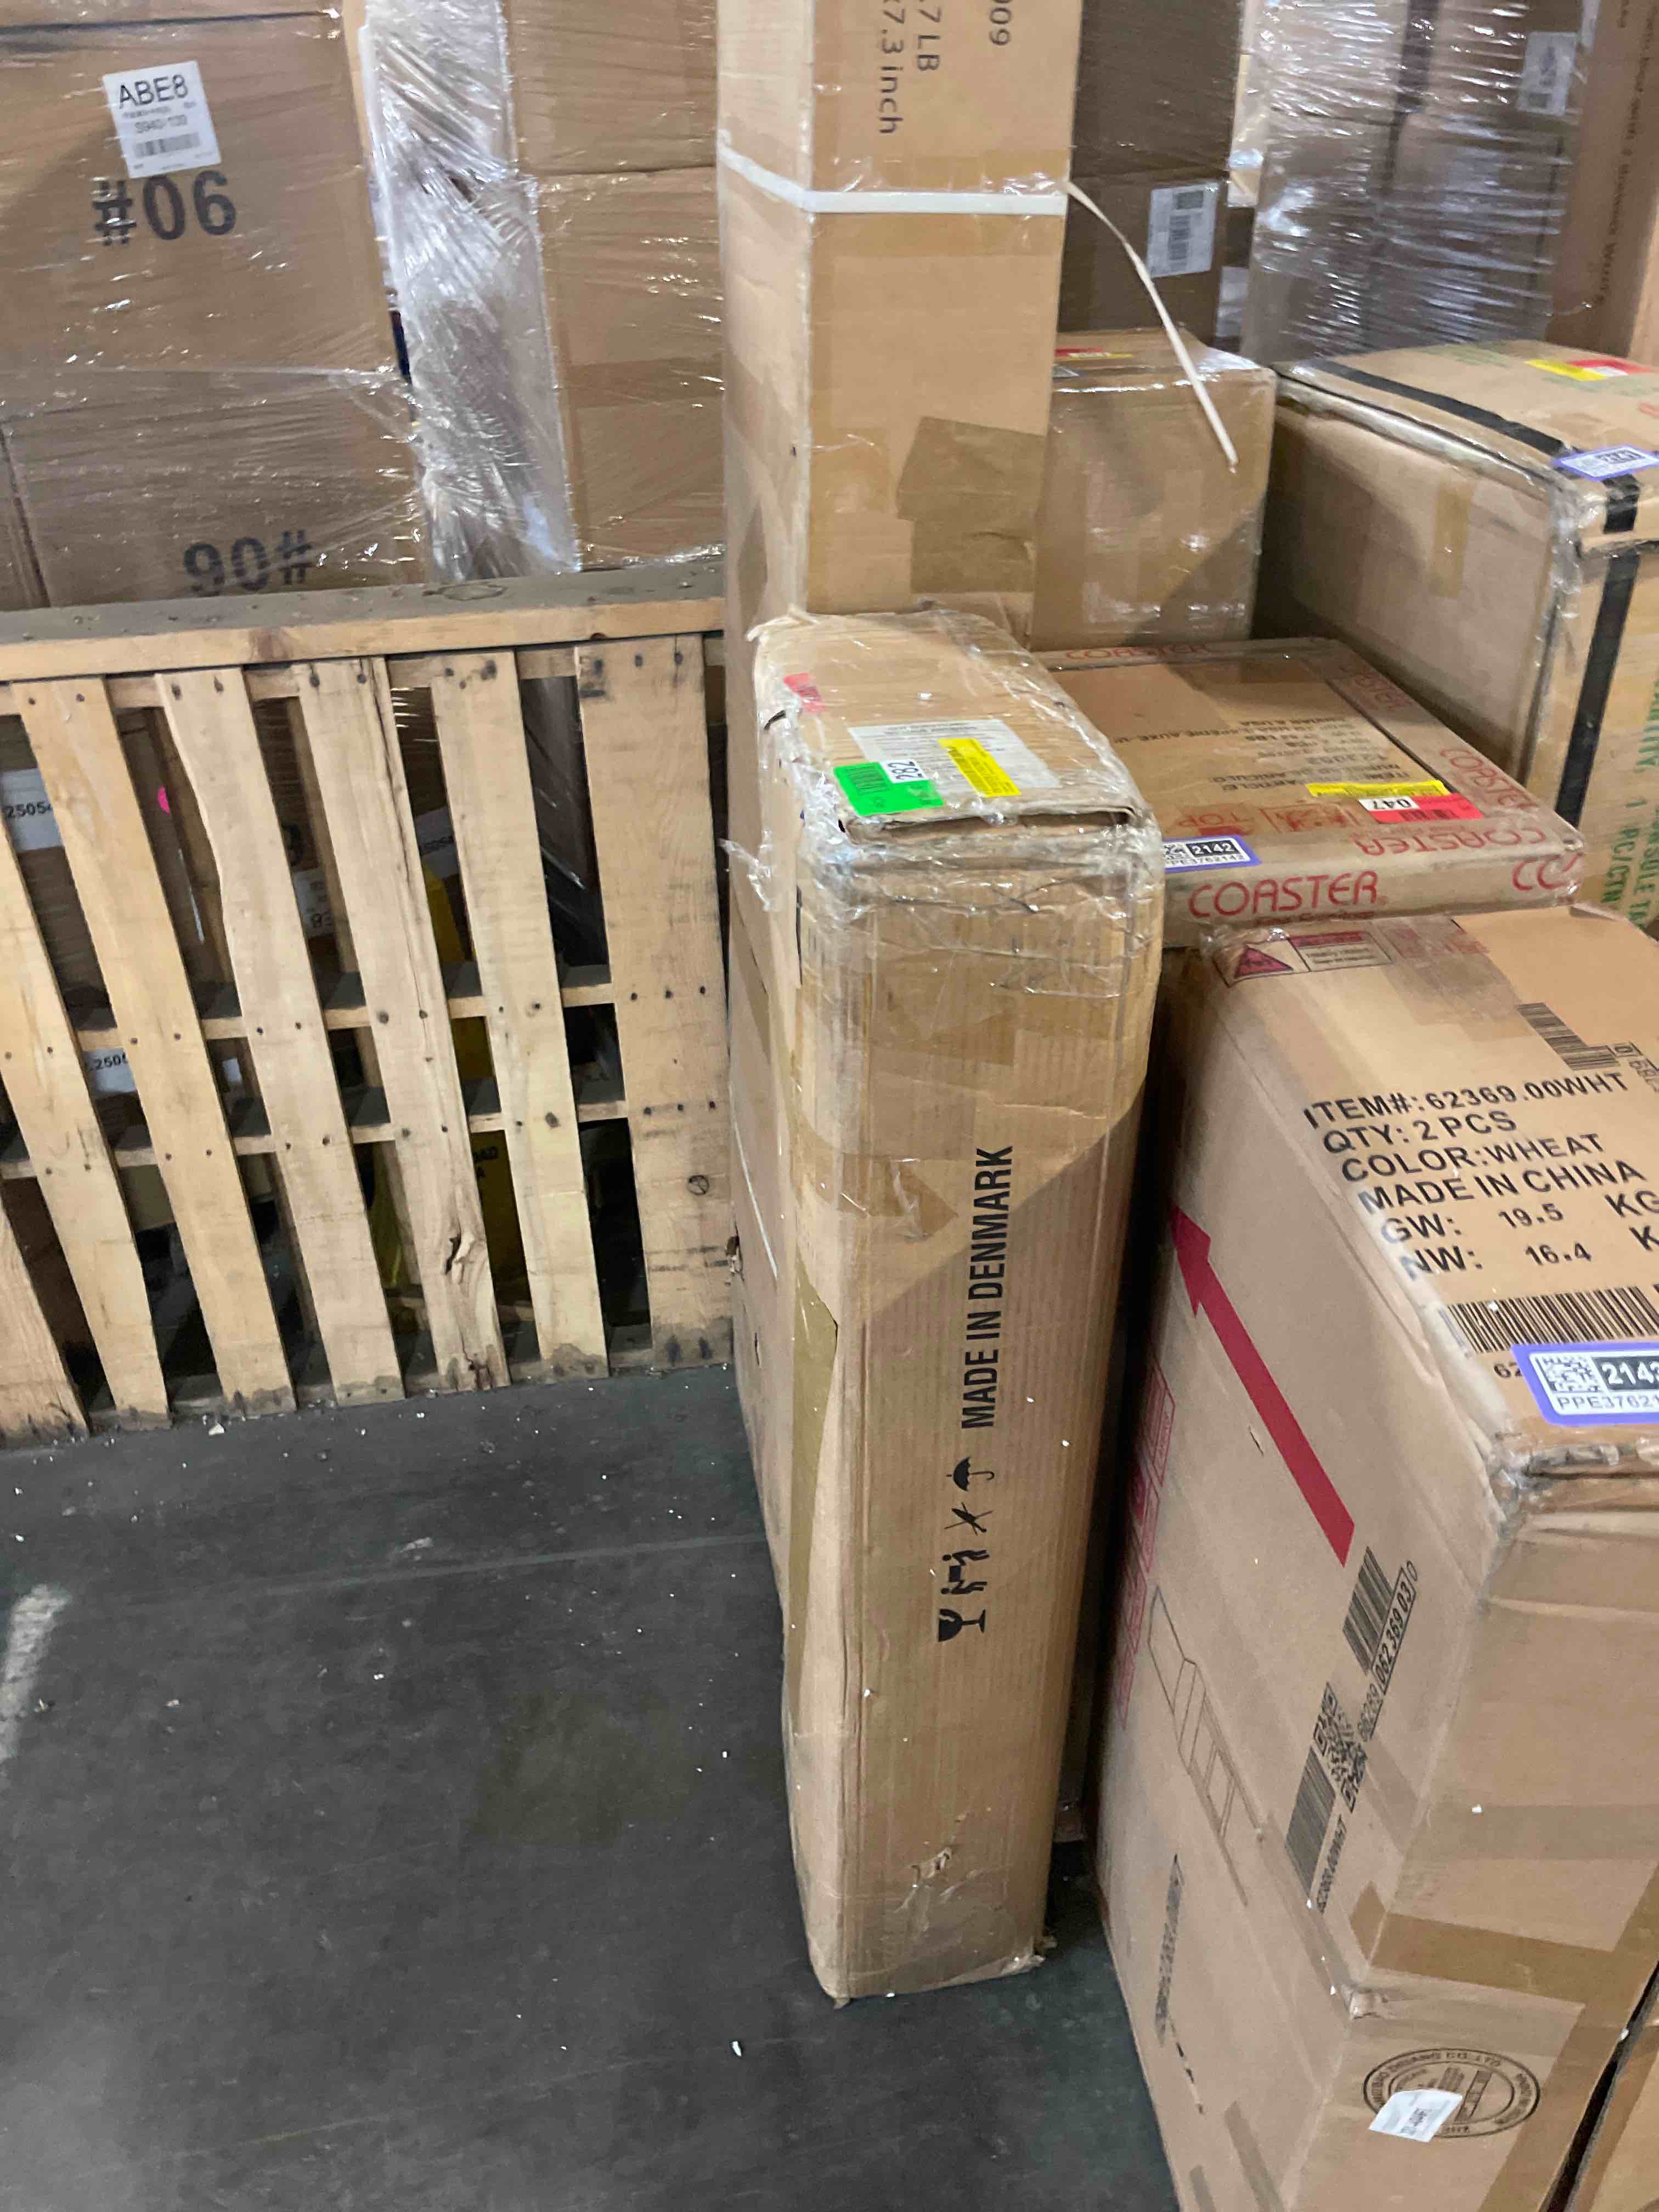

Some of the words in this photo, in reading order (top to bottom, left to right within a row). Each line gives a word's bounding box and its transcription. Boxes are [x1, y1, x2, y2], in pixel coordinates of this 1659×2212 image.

[917, 35, 941, 71] LB
[119, 74, 189, 109] ABE8
[878, 66, 904, 133] inch
[93, 170, 237, 246] #06
[887, 760, 924, 781] 282
[1372, 798, 1412, 810] 047
[1192, 842, 1235, 855] 2142
[1354, 826, 1546, 856] COASTER
[1188, 870, 1379, 918] COASTER
[1323, 1124, 1409, 1153] QTY:
[1413, 1120, 1439, 1141] 2
[1439, 1110, 1517, 1137] PCS
[1358, 1178, 1475, 1215] MADE
[1473, 1172, 1519, 1197] IN
[1522, 1160, 1648, 1193] CHINA
[968, 1146, 1013, 1301] DENMARK
[1381, 1212, 1462, 1243] GW:
[1498, 1203, 1564, 1229] 19.5
[1400, 1244, 1483, 1282] NW:
[1525, 1242, 1592, 1266] 16.4
[967, 1312, 1001, 1341] IN
[961, 1348, 998, 1429] MADE
[1386, 1607, 1404, 1650] 369
